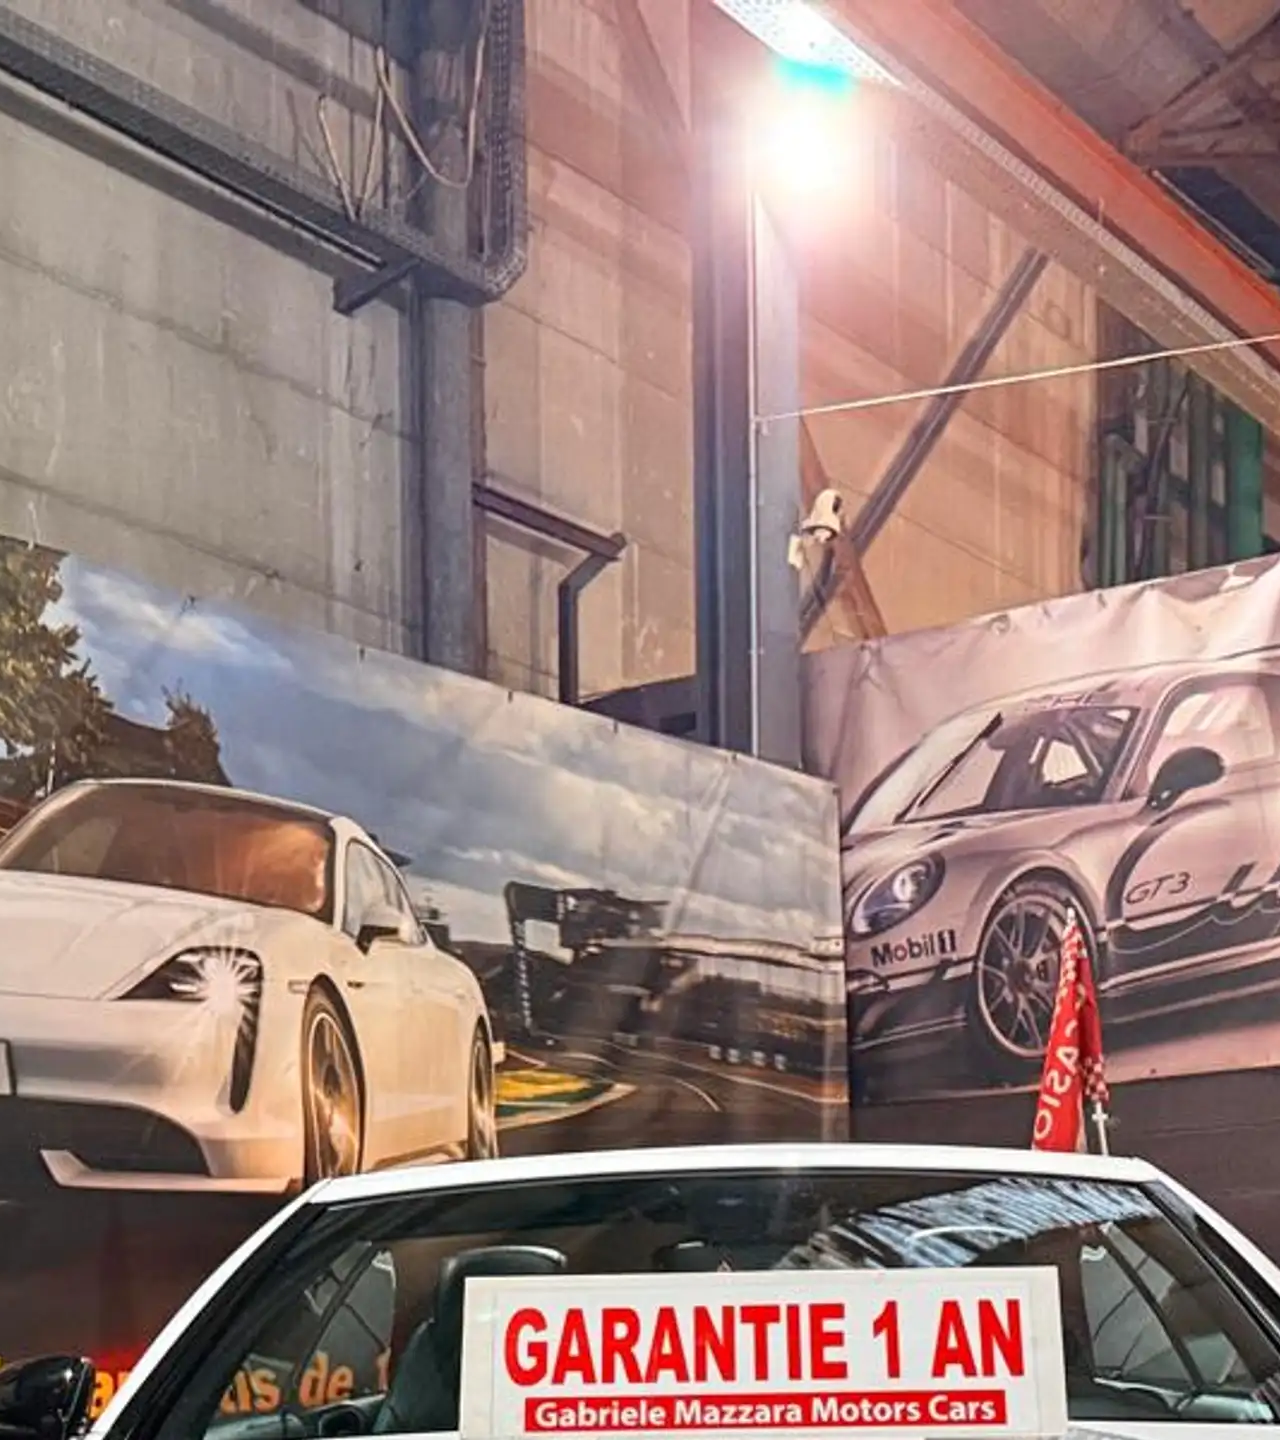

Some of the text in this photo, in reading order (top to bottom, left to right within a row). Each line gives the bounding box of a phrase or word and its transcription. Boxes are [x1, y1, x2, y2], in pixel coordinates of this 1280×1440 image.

[1127, 872, 1191, 904] GT3
[504, 1299, 1025, 1387] GARANTIE 1 AN
[299, 1352, 357, 1406] de
[535, 1396, 995, 1428] Gabriele Mazzara Motors Cars
